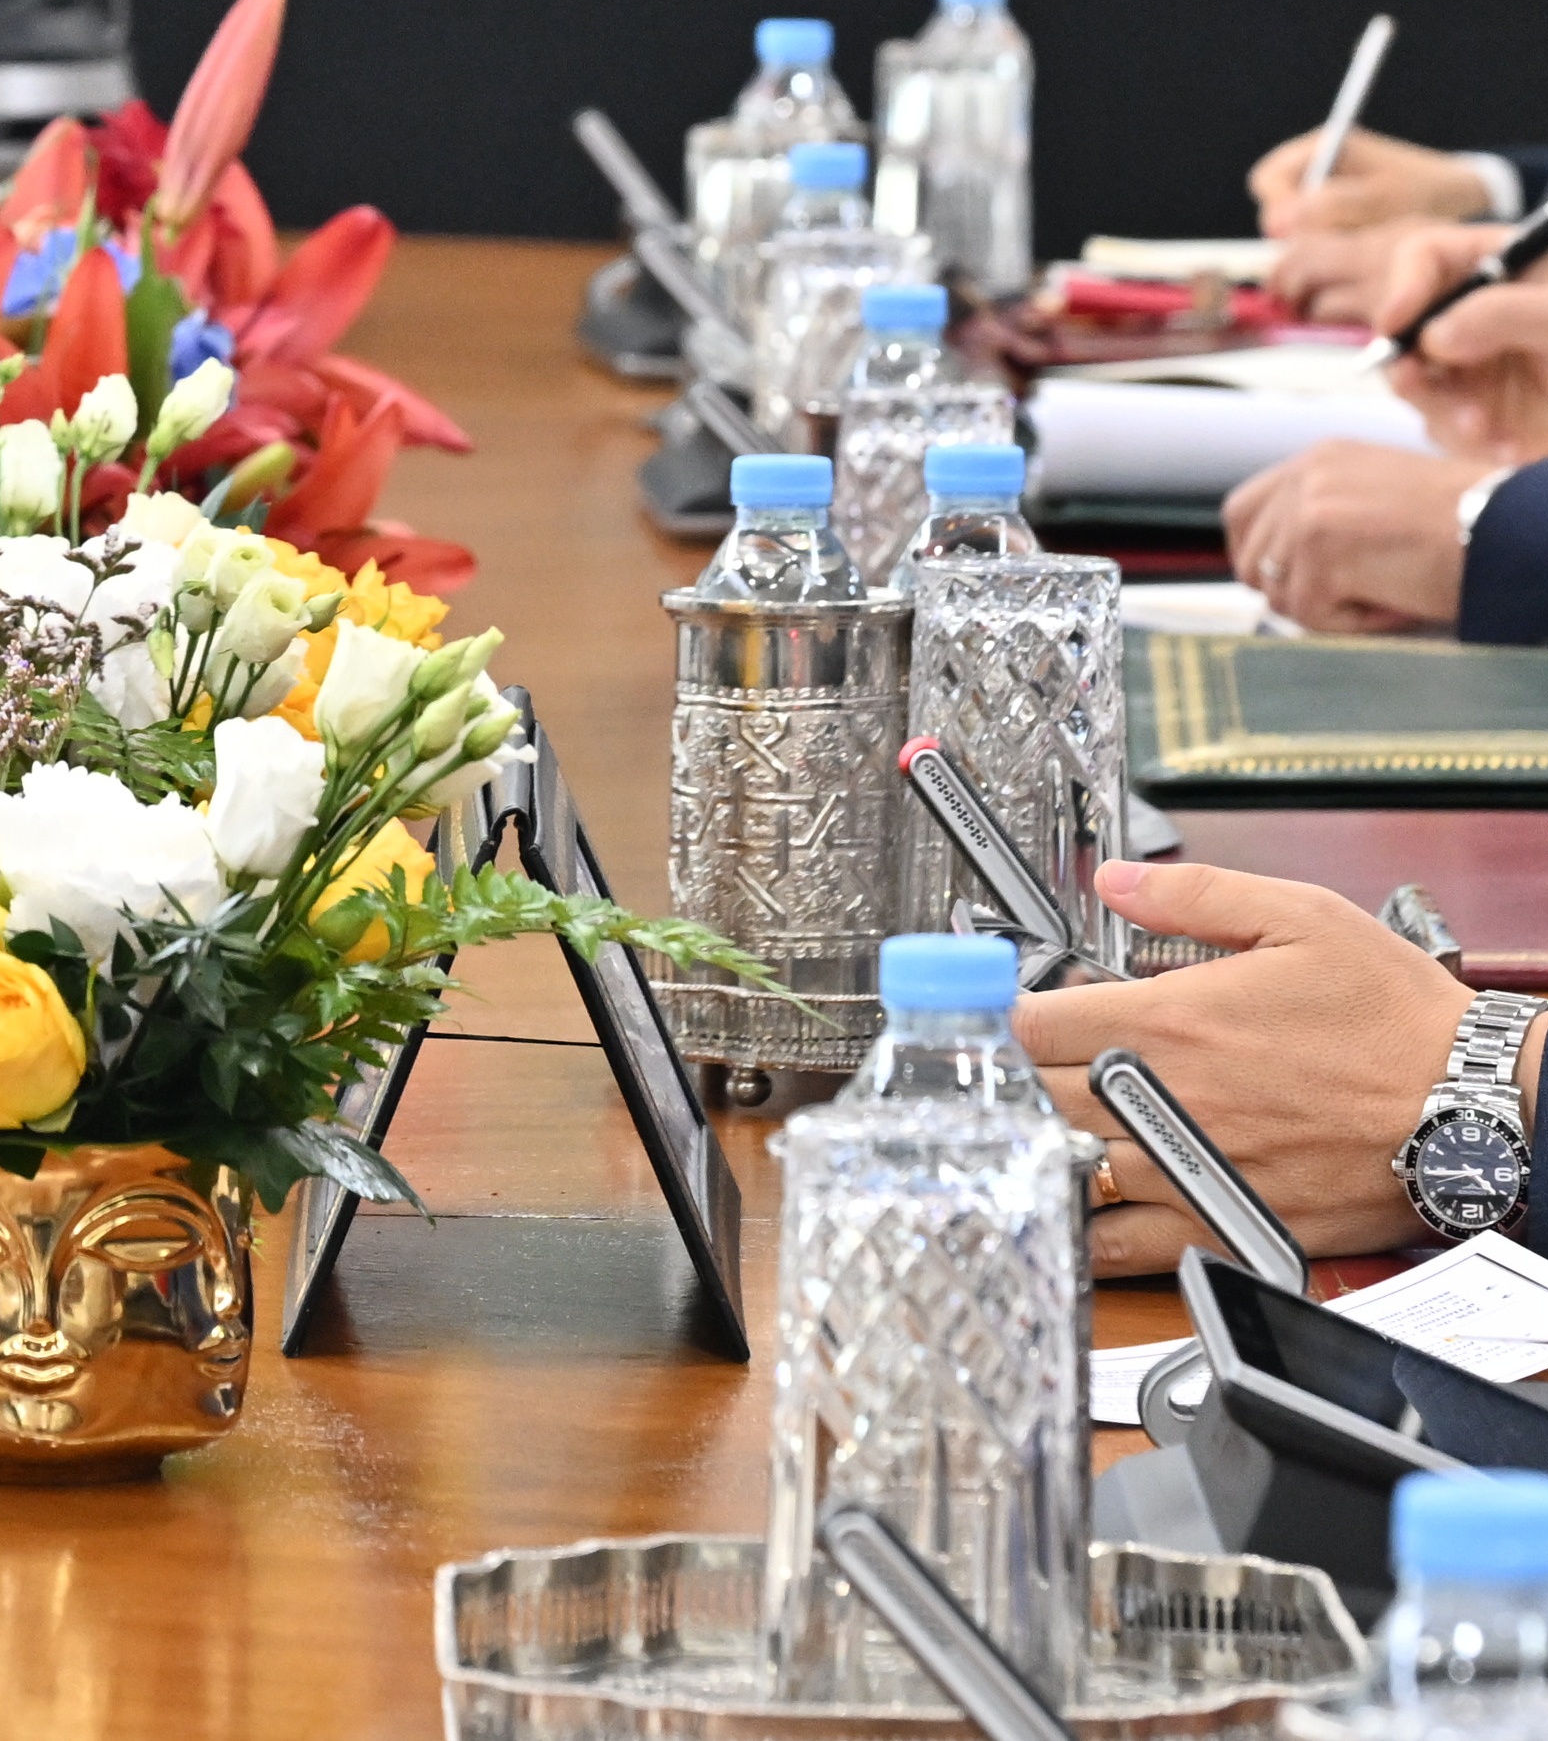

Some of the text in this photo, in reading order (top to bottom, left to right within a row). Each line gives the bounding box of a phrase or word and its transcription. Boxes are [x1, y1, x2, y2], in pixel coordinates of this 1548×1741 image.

[1455, 1109, 1476, 1121] 30
[1406, 1168, 1416, 1181] 15
[1462, 1203, 1483, 1218] 12
